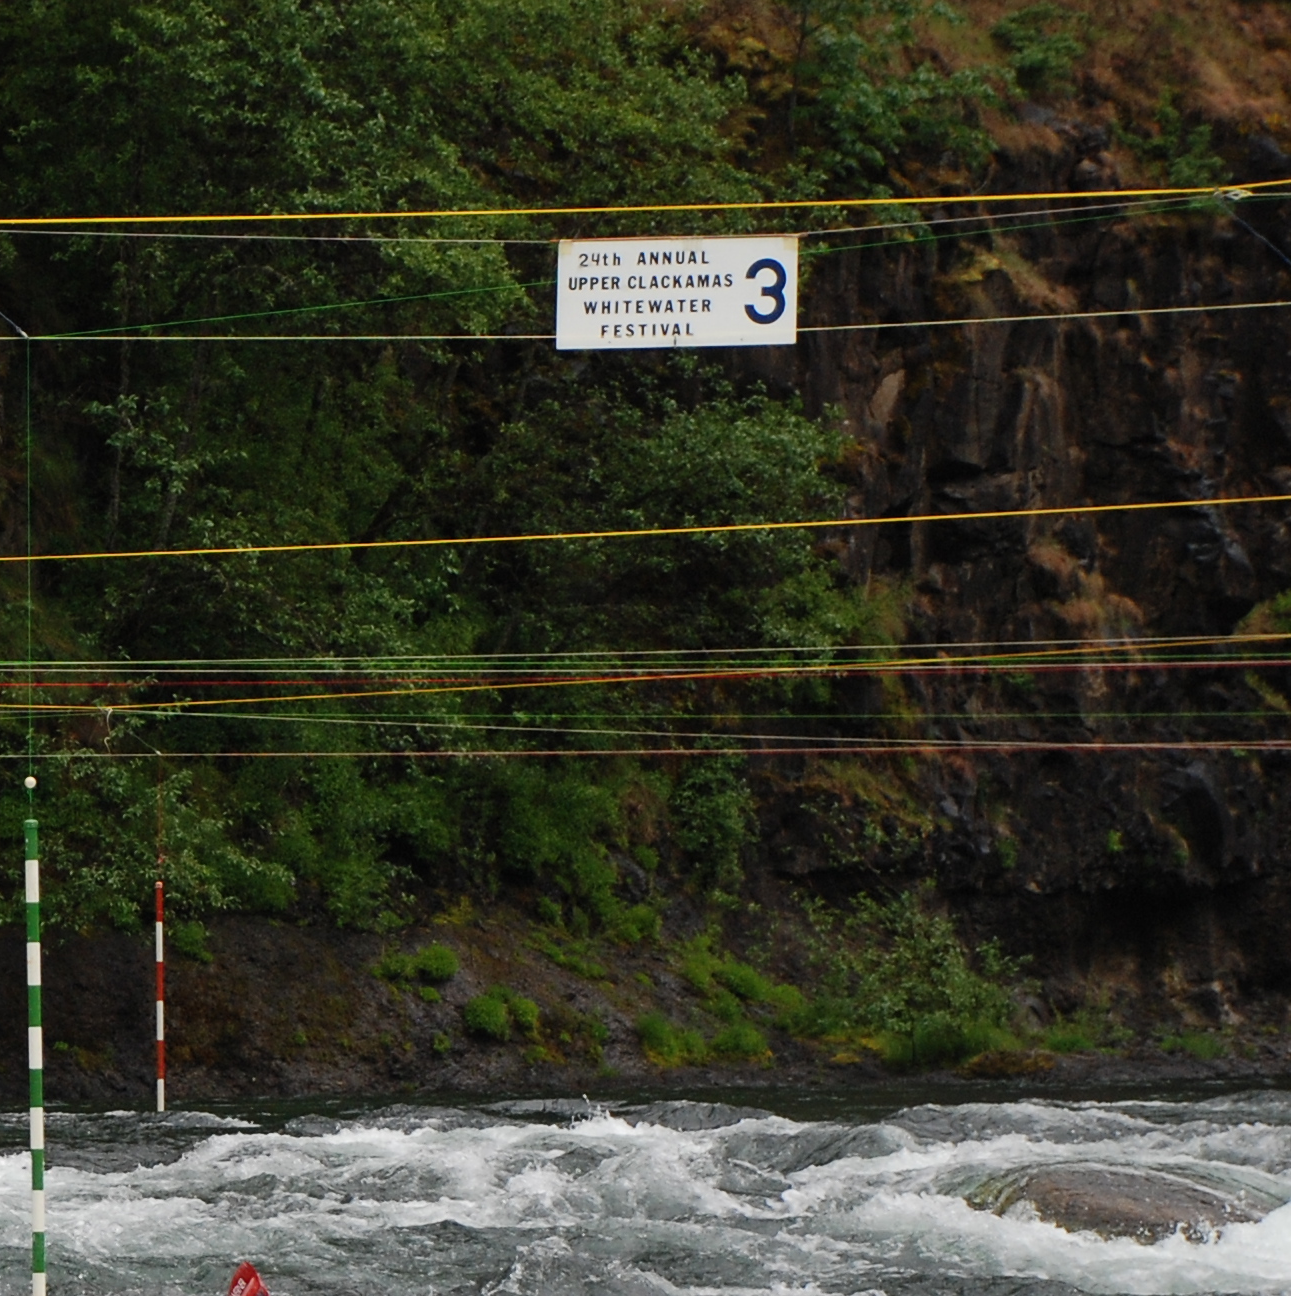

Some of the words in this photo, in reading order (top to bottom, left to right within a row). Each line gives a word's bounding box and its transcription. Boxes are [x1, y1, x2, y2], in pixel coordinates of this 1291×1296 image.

[578, 252, 621, 267] 24th
[637, 251, 710, 266] ANNUAL
[568, 276, 620, 291] UPPER
[627, 273, 734, 290] CLACKAMAS
[744, 257, 787, 325] 3
[583, 299, 712, 315] WHITEWATER
[600, 323, 694, 338] FESTIVAL
